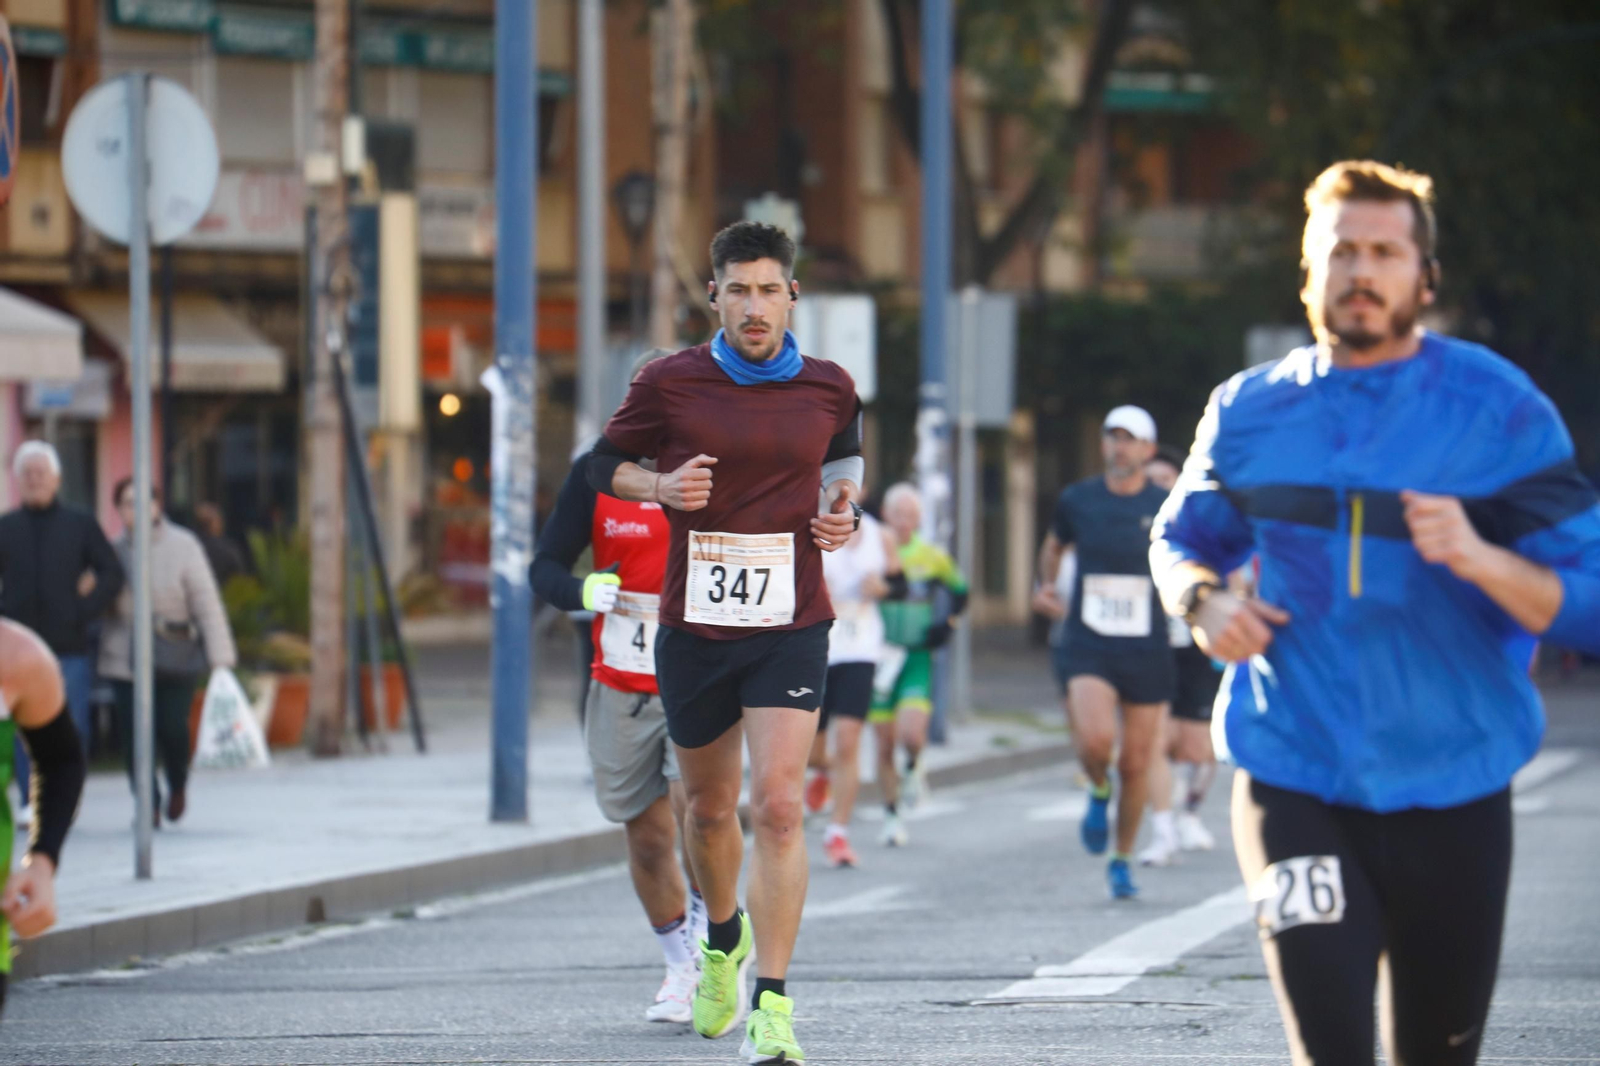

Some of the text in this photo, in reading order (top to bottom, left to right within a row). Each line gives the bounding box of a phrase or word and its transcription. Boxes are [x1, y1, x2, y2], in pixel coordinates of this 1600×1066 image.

[692, 534, 723, 562] XLI
[708, 565, 771, 606] 347
[632, 622, 647, 653] 4
